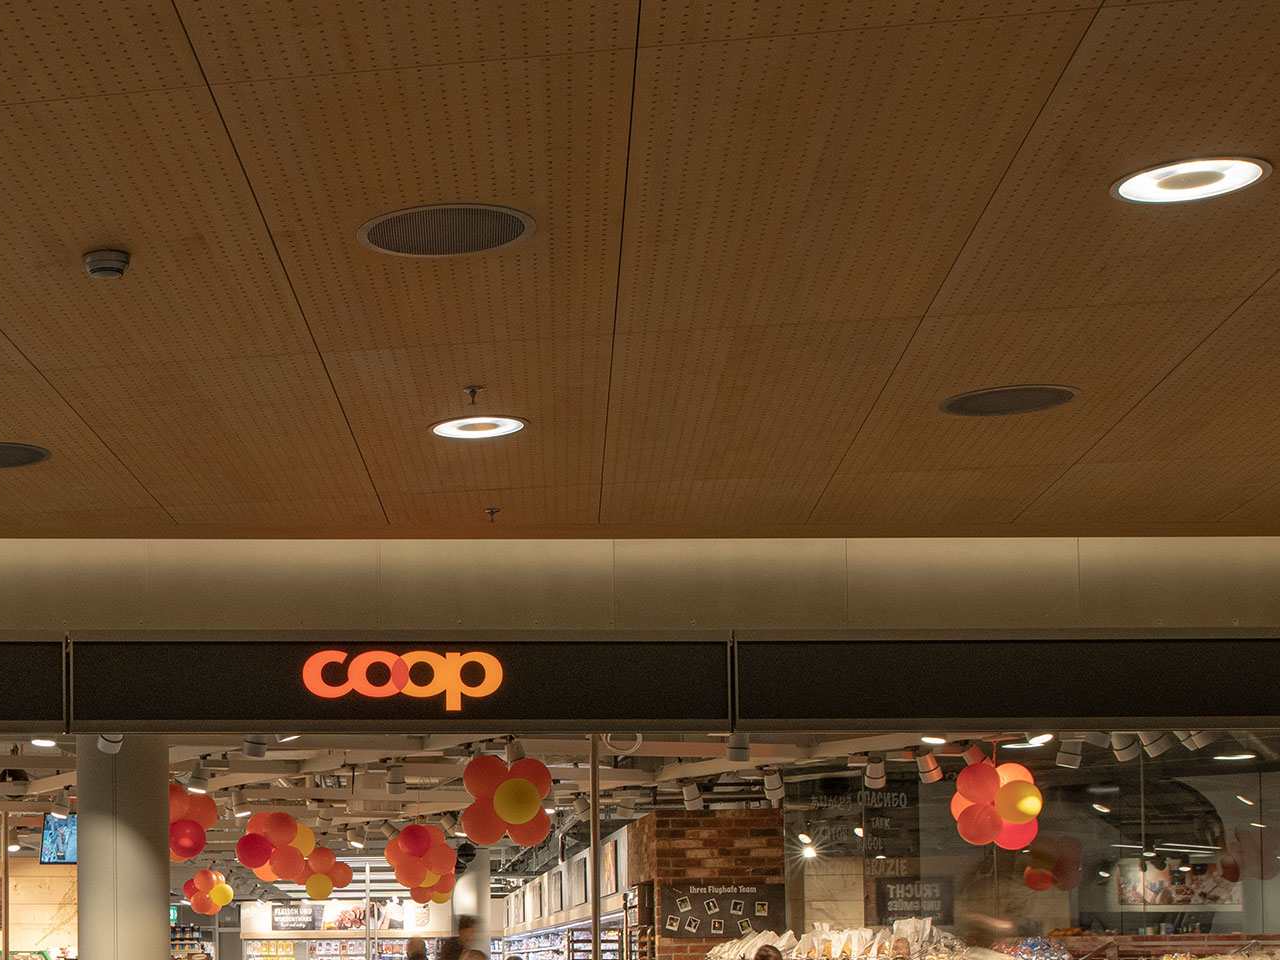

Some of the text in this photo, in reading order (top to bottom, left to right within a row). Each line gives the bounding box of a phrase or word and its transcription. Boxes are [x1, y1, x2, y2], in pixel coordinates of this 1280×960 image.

[302, 650, 504, 712] coop
[857, 790, 908, 808] СПАСИБО
[865, 857, 908, 877] GRAZIE
[739, 885, 757, 893] Team
